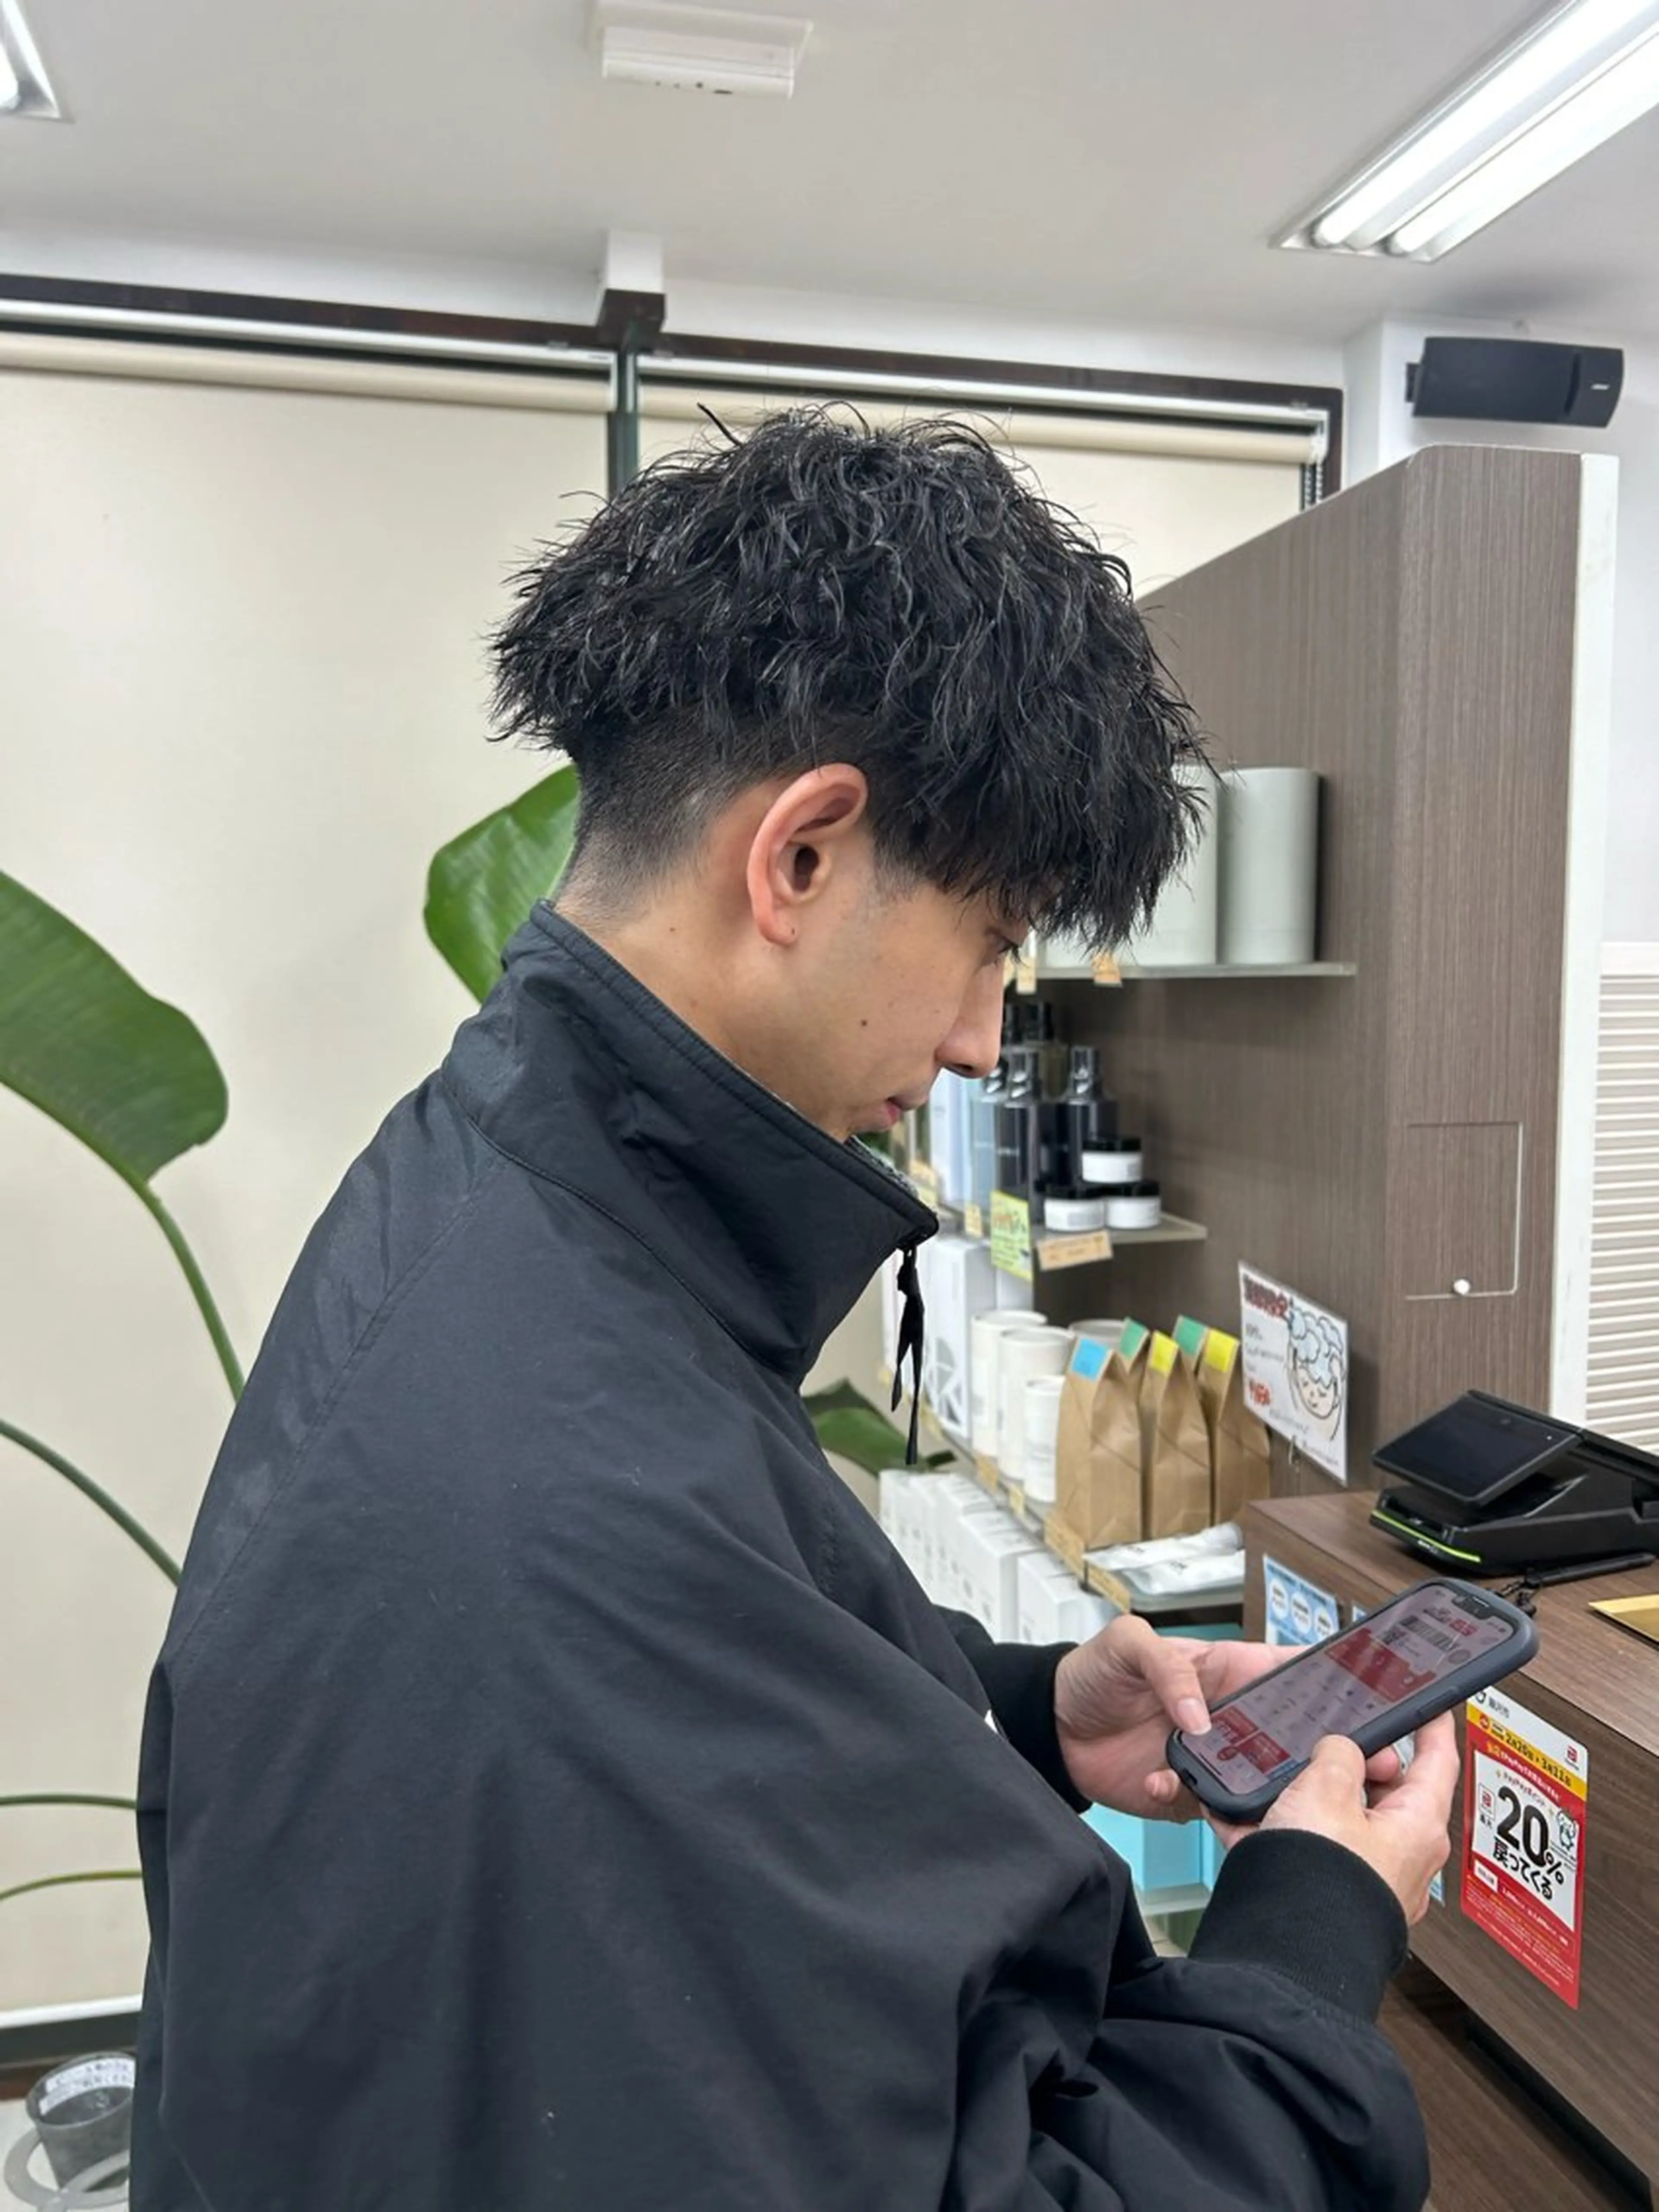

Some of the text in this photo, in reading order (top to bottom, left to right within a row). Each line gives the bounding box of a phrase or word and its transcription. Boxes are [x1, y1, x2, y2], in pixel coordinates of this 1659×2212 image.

[1493, 1836, 1553, 1901] 戻ってくる
[1497, 1785, 1564, 1885] 20%
